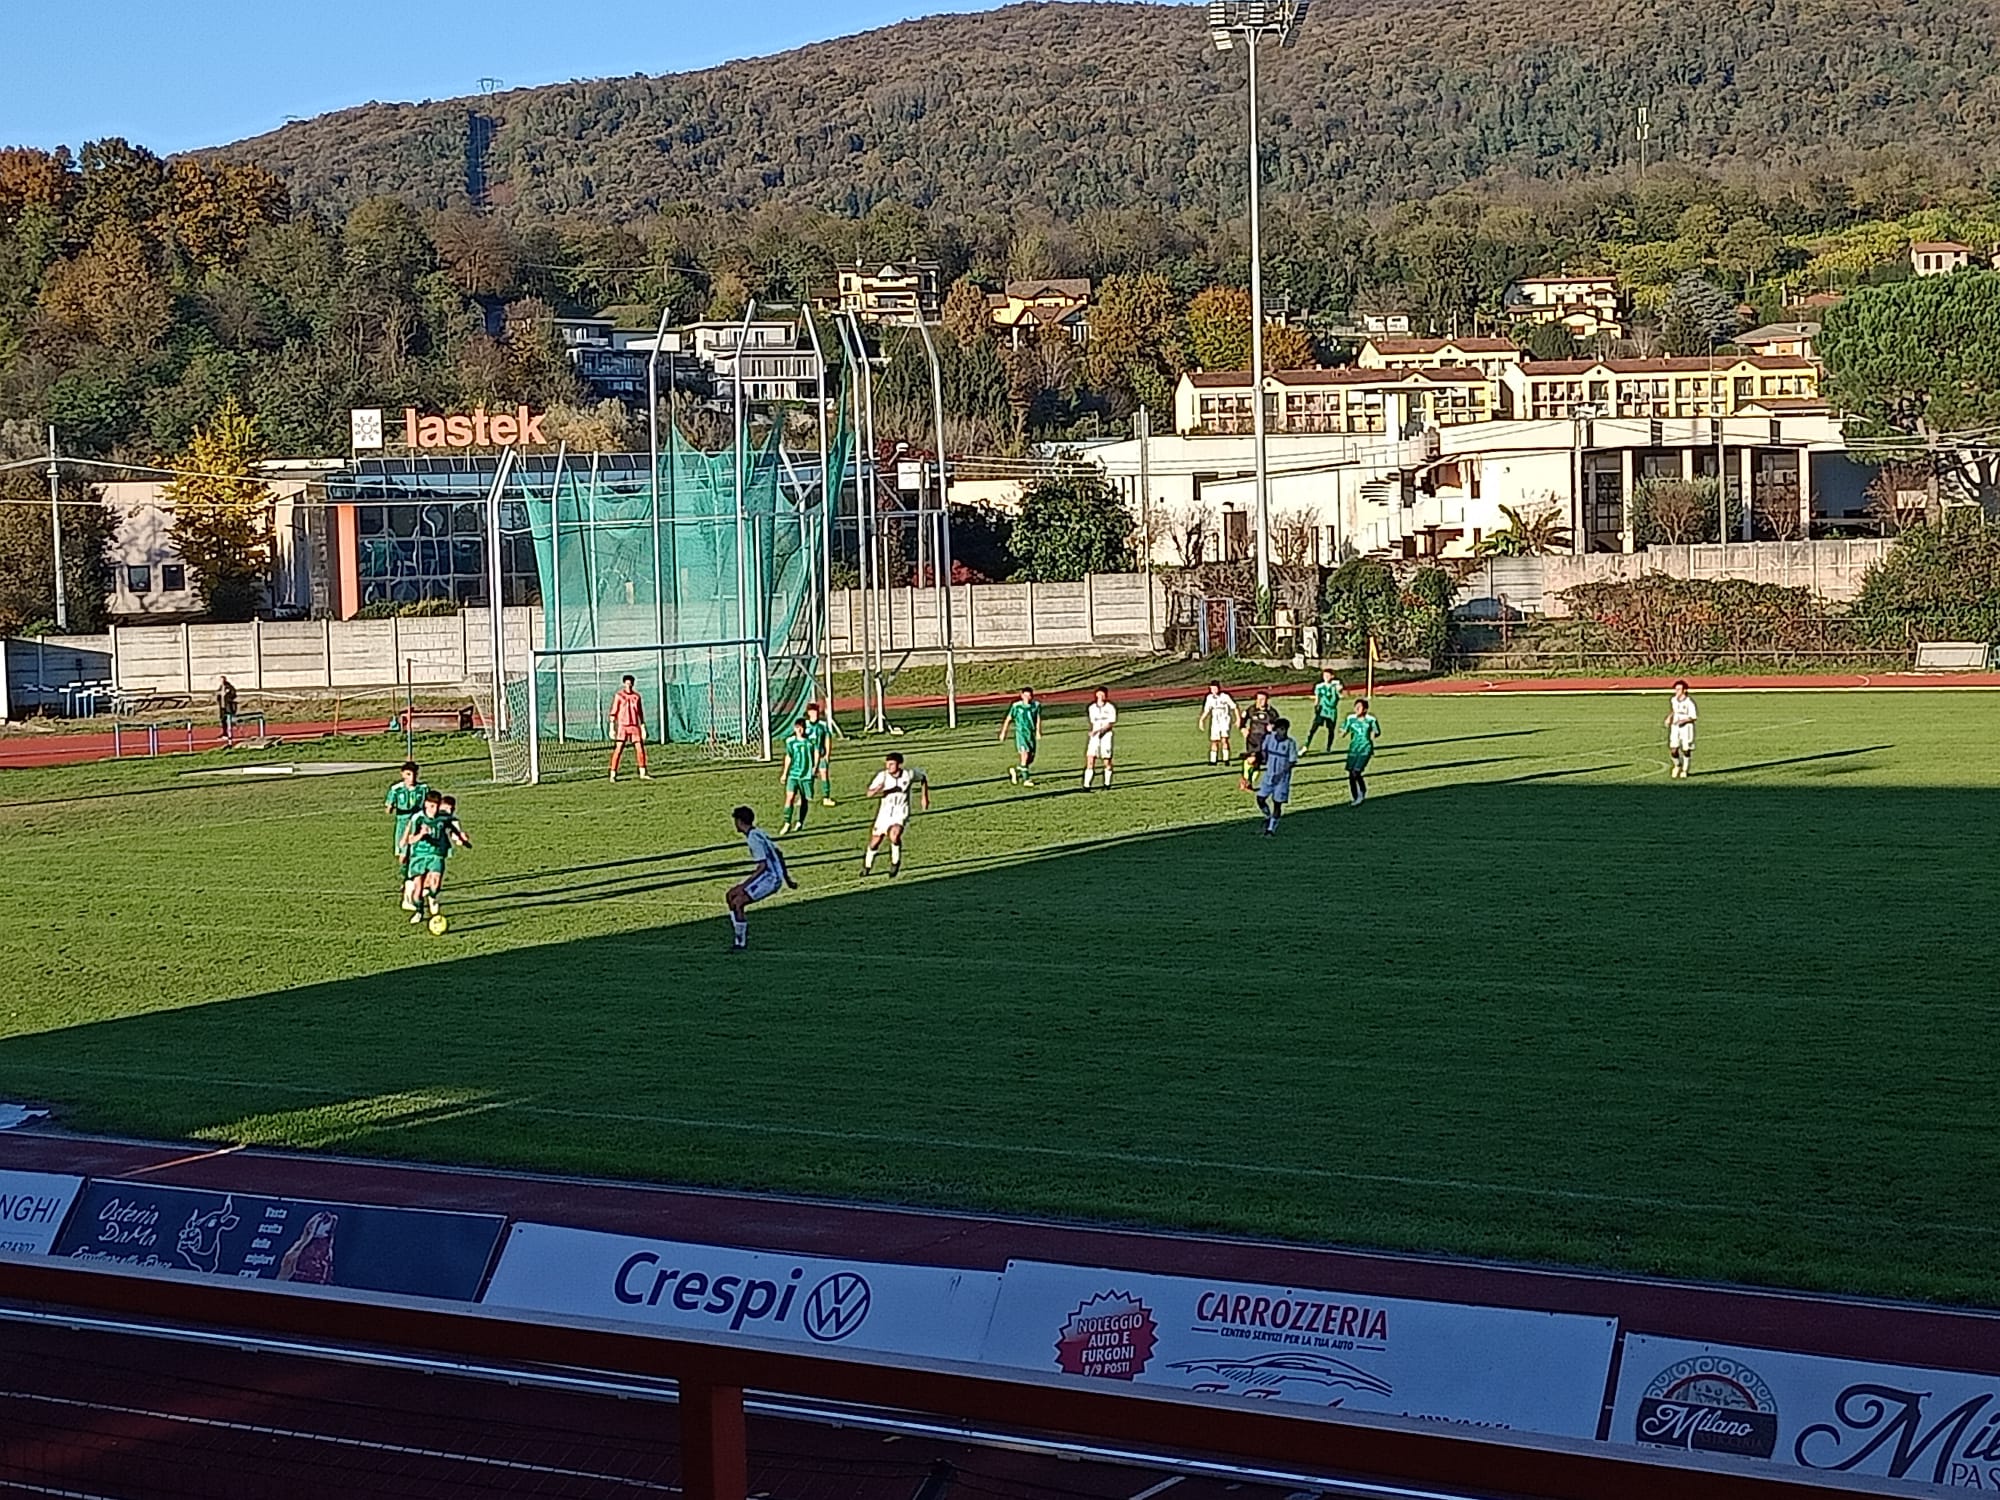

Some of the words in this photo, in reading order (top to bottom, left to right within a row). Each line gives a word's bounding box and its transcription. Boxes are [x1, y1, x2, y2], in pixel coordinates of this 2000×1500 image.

[406, 405, 547, 448] lastek
[614, 1252, 803, 1330] Crespi
[1077, 1314, 1143, 1335] NOLEGGIO
[1197, 1292, 1387, 1340] CARROZZERIA
[1088, 1333, 1119, 1348] AUTO
[1122, 1331, 1131, 1345] E
[1221, 1327, 1251, 1339] CENTRO
[1252, 1331, 1283, 1342] SERVIZI
[1284, 1334, 1300, 1344] PER
[1302, 1336, 1312, 1346] LA
[1314, 1338, 1329, 1348] TUA
[1331, 1340, 1354, 1351] AUTO
[1081, 1346, 1135, 1363] FURGONI
[1083, 1364, 1102, 1377] 8/9
[1104, 1362, 1130, 1374] POSTI
[1642, 1404, 1755, 1452] Milano
